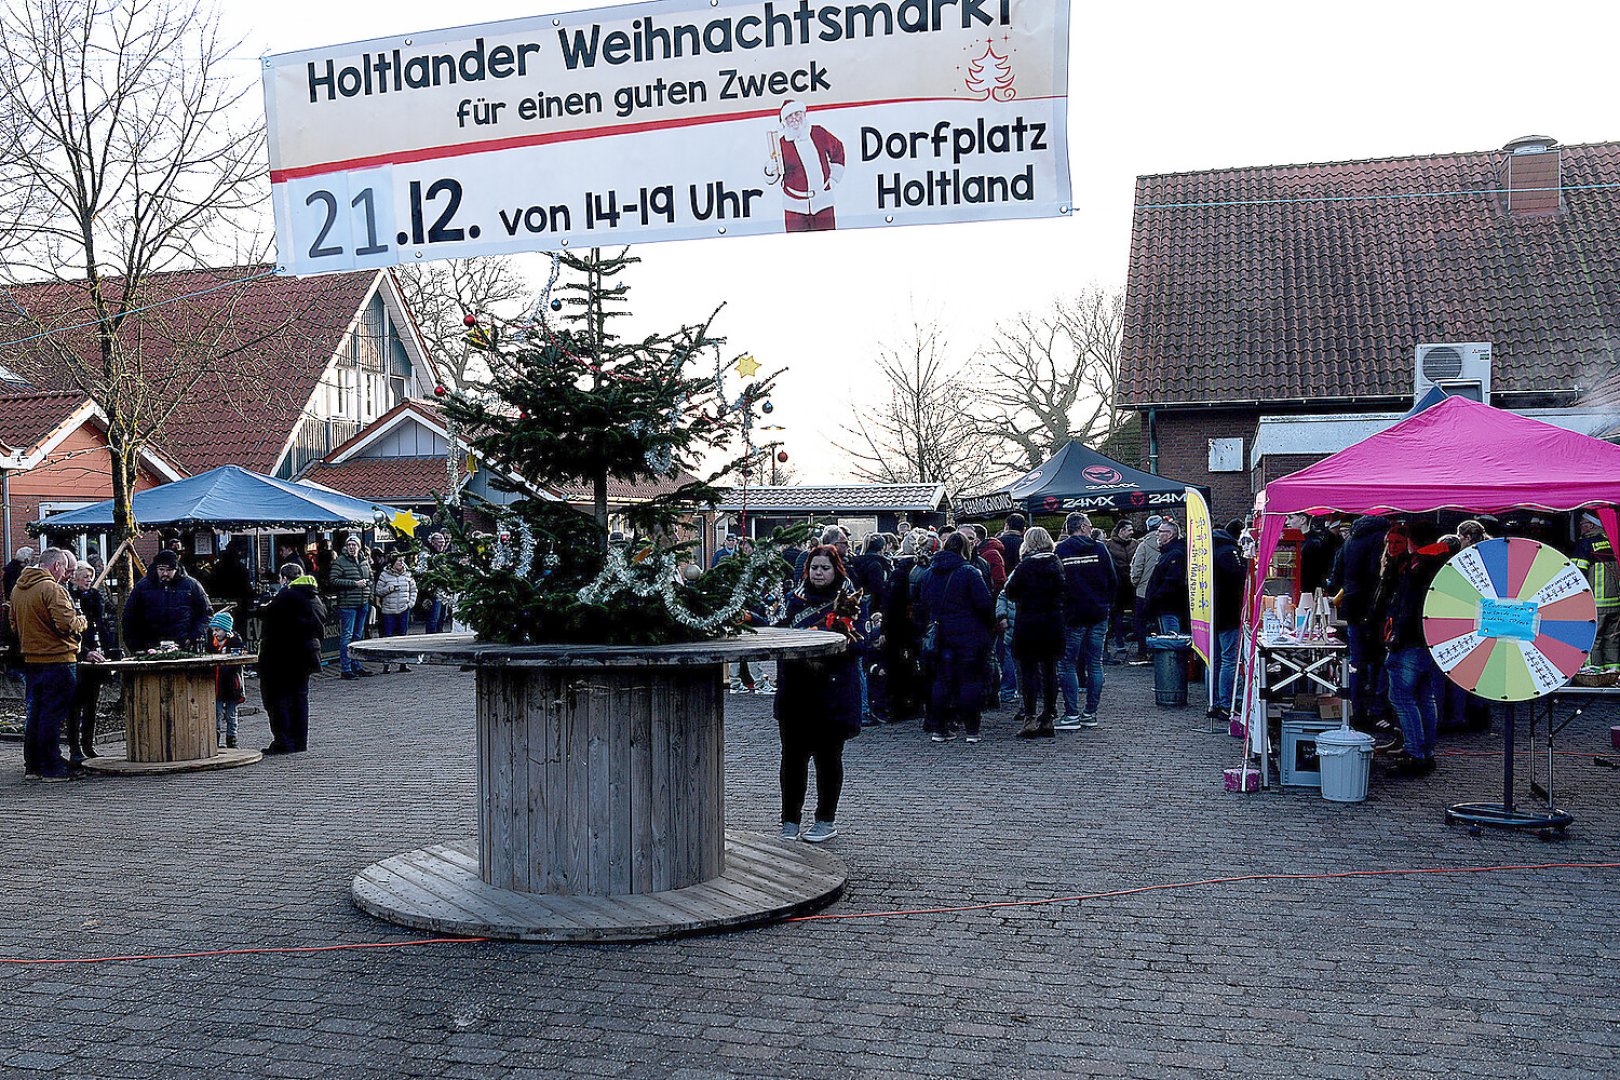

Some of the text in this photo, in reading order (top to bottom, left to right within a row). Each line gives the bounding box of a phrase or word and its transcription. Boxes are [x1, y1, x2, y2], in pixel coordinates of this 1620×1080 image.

[307, 38, 541, 103] Holtlander
[456, 61, 831, 127] für einen guten Zweck
[861, 116, 1048, 164] Dorfplatz
[877, 164, 1034, 209] Holtland
[306, 178, 763, 259] 21.12. von 14-19 Uhr
[1062, 495, 1116, 509] 24MX
[1148, 493, 1187, 504] 24M
